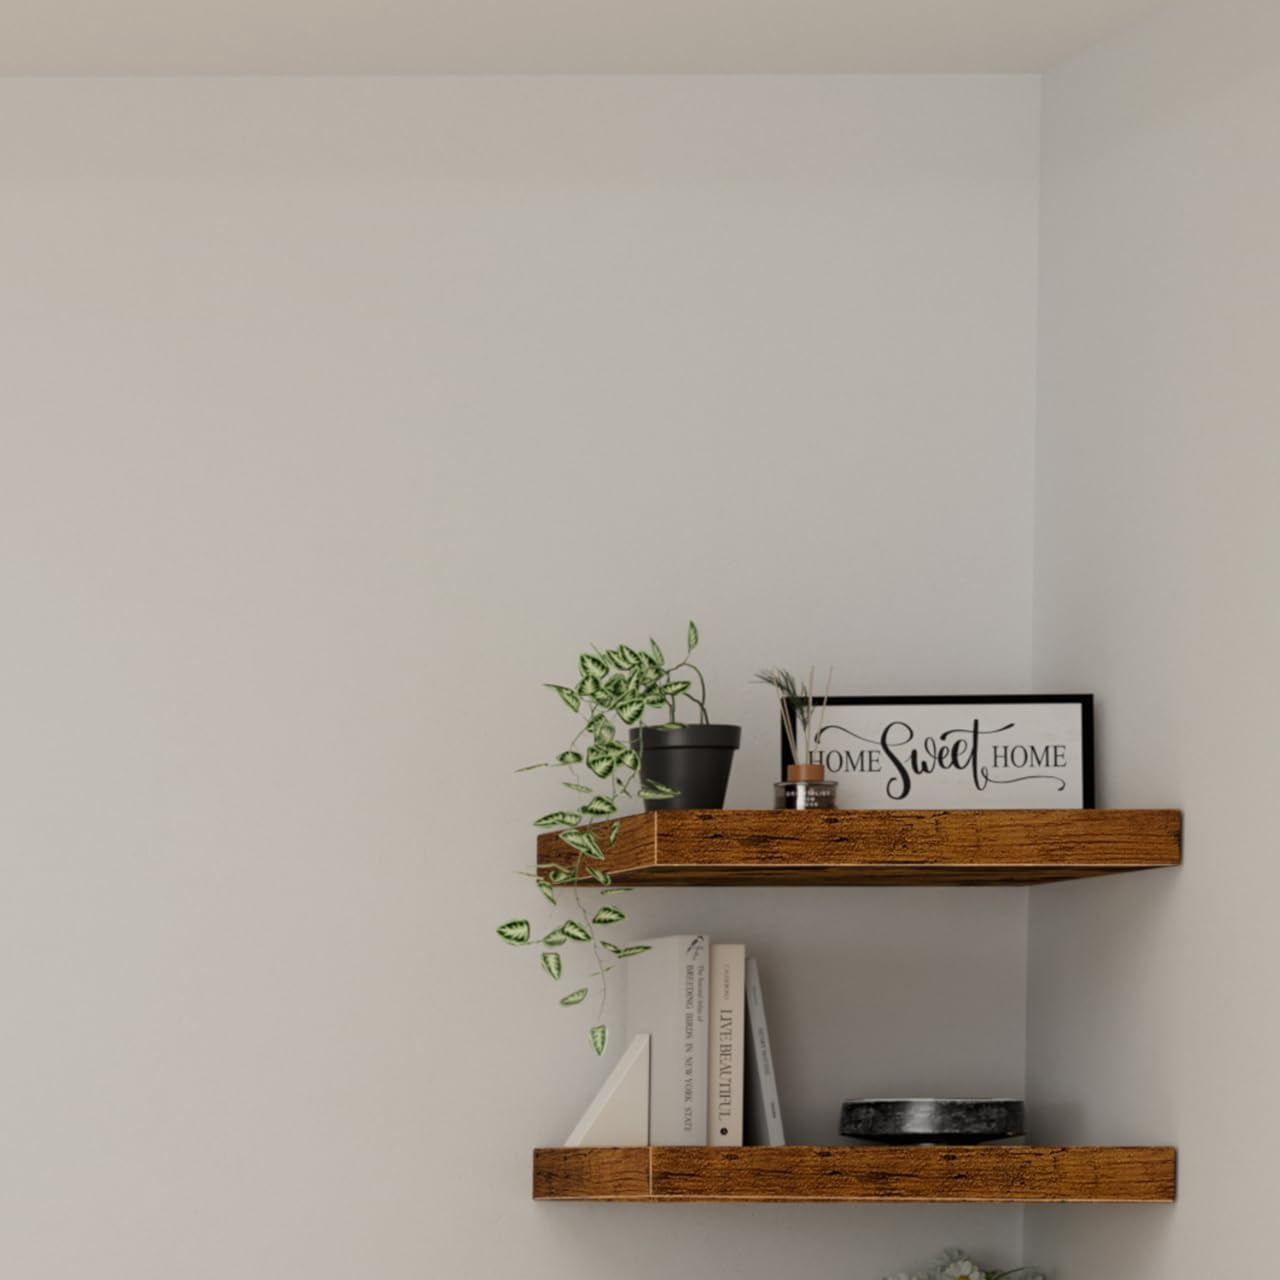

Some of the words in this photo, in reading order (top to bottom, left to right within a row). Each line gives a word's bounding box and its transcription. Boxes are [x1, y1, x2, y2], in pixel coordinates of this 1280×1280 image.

[809, 750, 882, 773] HOME
[880, 719, 1015, 800] Sweet
[992, 745, 1067, 768] HOME
[686, 965, 694, 1009] BREEDING
[685, 1013, 694, 1038] BIRDS
[720, 1009, 733, 1040] LIVE
[684, 1043, 693, 1053] IN
[684, 1056, 693, 1075] NEW
[684, 1079, 693, 1102] YORK
[719, 1044, 733, 1121] BEAUTIFUL
[683, 1107, 693, 1131] STATE
